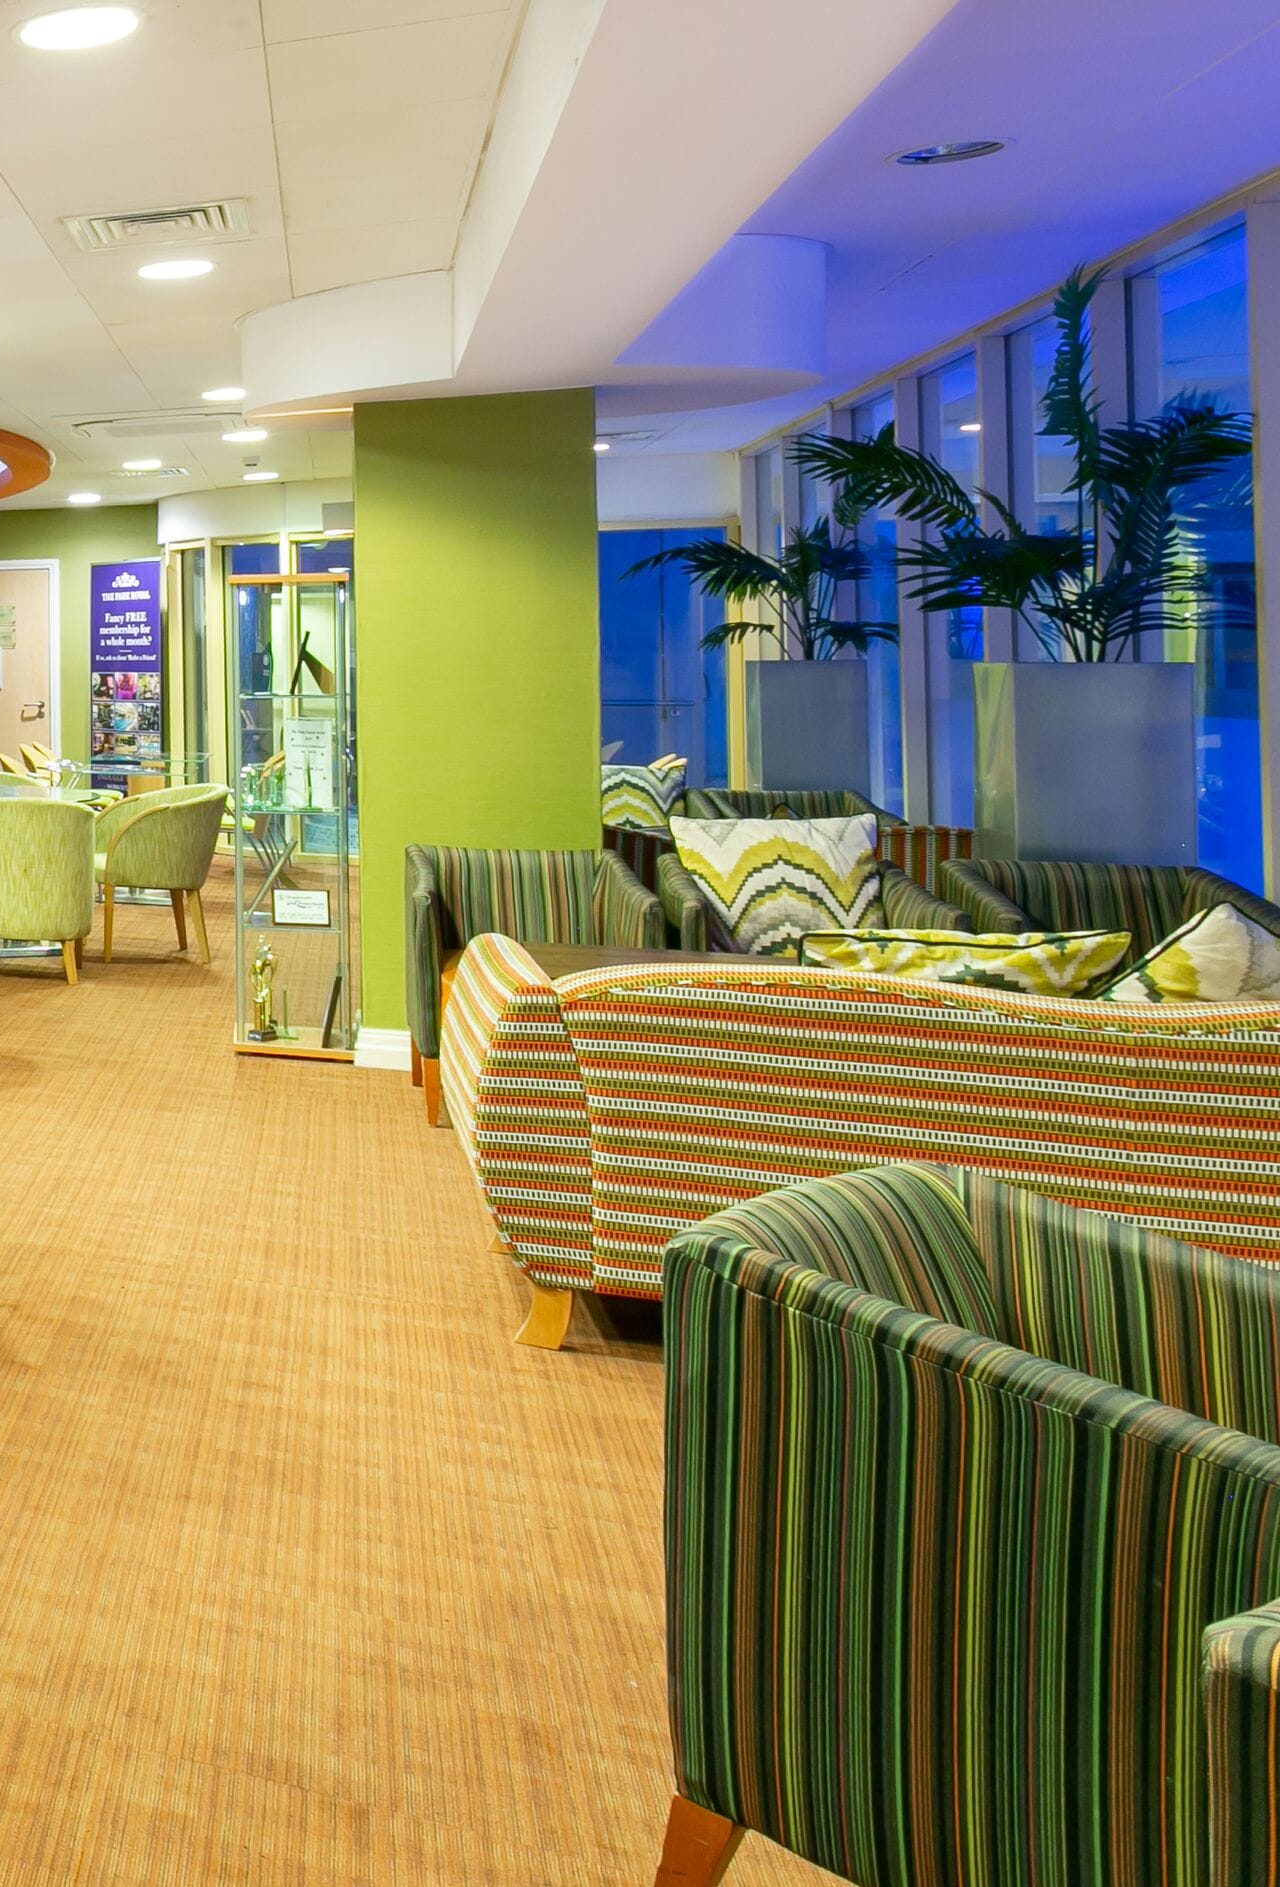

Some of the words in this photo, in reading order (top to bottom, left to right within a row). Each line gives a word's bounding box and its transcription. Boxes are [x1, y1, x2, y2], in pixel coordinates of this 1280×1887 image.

[101, 592, 114, 601] THE
[115, 591, 130, 600] PARK
[130, 590, 151, 600] ROYAL
[105, 613, 124, 624] Fancy
[125, 611, 147, 622] FREE
[99, 624, 139, 636] membership
[140, 623, 151, 634] for
[106, 636, 125, 646] whole
[126, 635, 152, 646] month?
